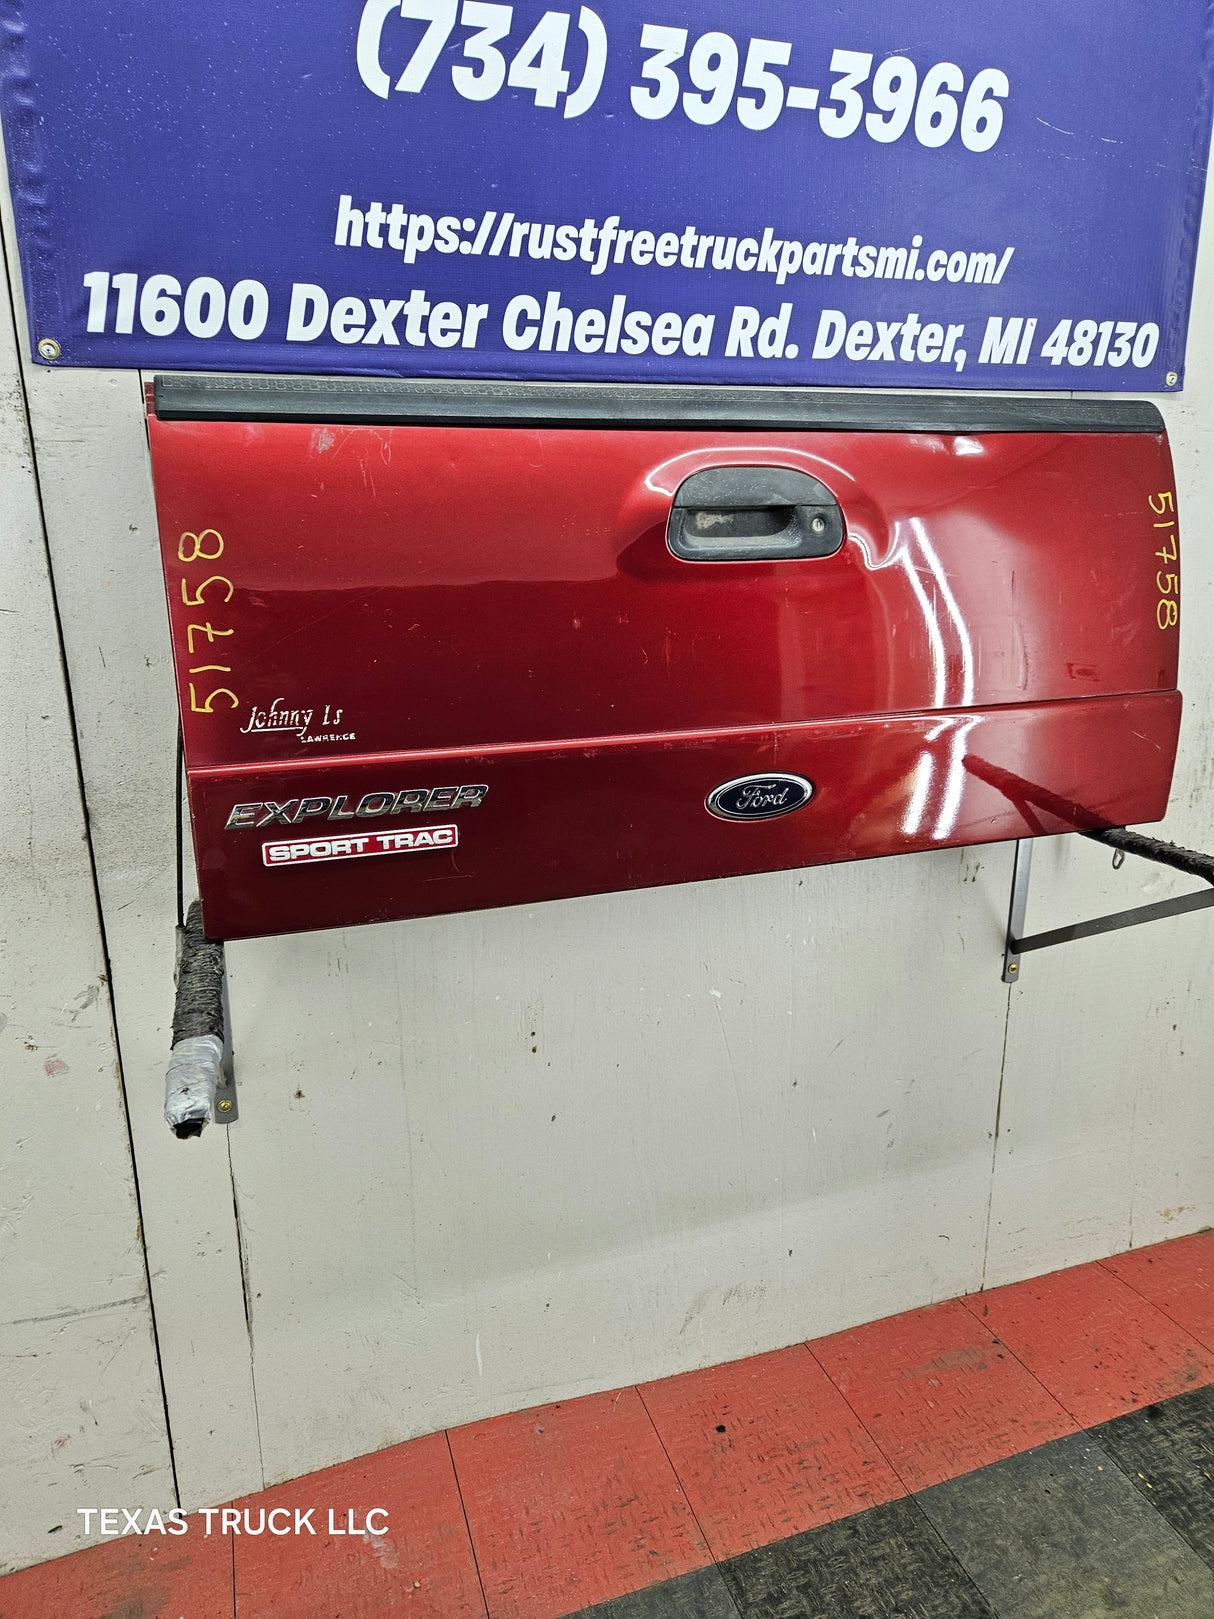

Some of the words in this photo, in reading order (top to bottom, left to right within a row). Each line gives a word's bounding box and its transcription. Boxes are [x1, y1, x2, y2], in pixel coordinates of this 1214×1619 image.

[357, 0, 607, 118] (734)
[631, 24, 1009, 152] 395-3966
[335, 195, 1015, 284] https://rustfreetruckpartsmi.com/
[84, 272, 268, 339] 11600
[287, 283, 488, 348] Dexter
[503, 292, 715, 356] Chelsea
[725, 303, 798, 358] Rd.
[812, 310, 966, 371] Dexter,
[978, 317, 1037, 364] MI
[1042, 320, 1159, 367] 48130
[1148, 491, 1179, 630] 51758
[178, 528, 239, 713] 51758
[224, 784, 489, 830] EXPLORER
[736, 783, 789, 810] Ford
[269, 838, 369, 862] SPORT
[376, 829, 453, 850] TRAC
